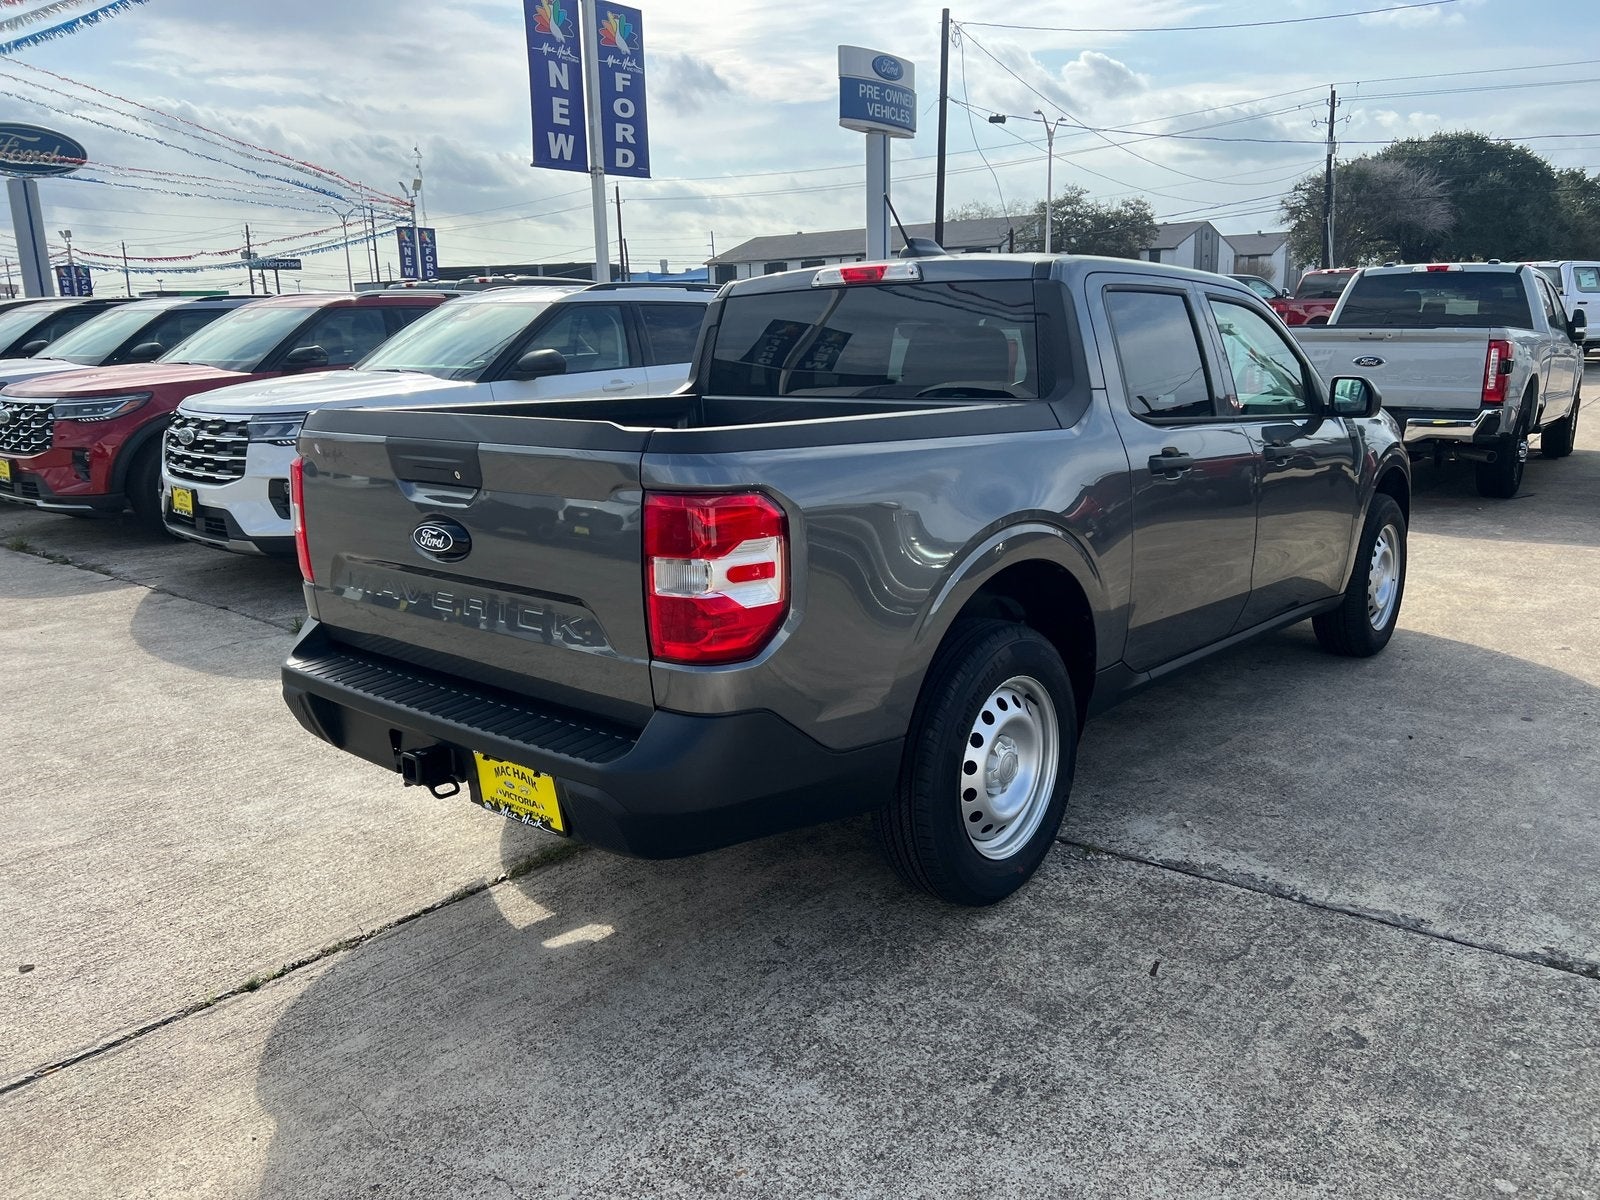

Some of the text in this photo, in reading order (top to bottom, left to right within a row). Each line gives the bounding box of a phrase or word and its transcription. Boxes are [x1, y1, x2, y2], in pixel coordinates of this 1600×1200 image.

[881, 58, 899, 76] Ford
[547, 60, 575, 161] NEW
[613, 72, 636, 168] FORD
[867, 102, 910, 124] VEHICLES
[251, 260, 301, 269] nterprise
[403, 246, 414, 276] NEW
[425, 247, 434, 277] FORD
[1360, 358, 1378, 366] Ford
[420, 528, 445, 548] Ford
[346, 569, 584, 640] MAVERICK
[494, 765, 538, 792] MAC HAIK
[501, 789, 539, 809] VICTORIA
[500, 805, 521, 822] Mac
